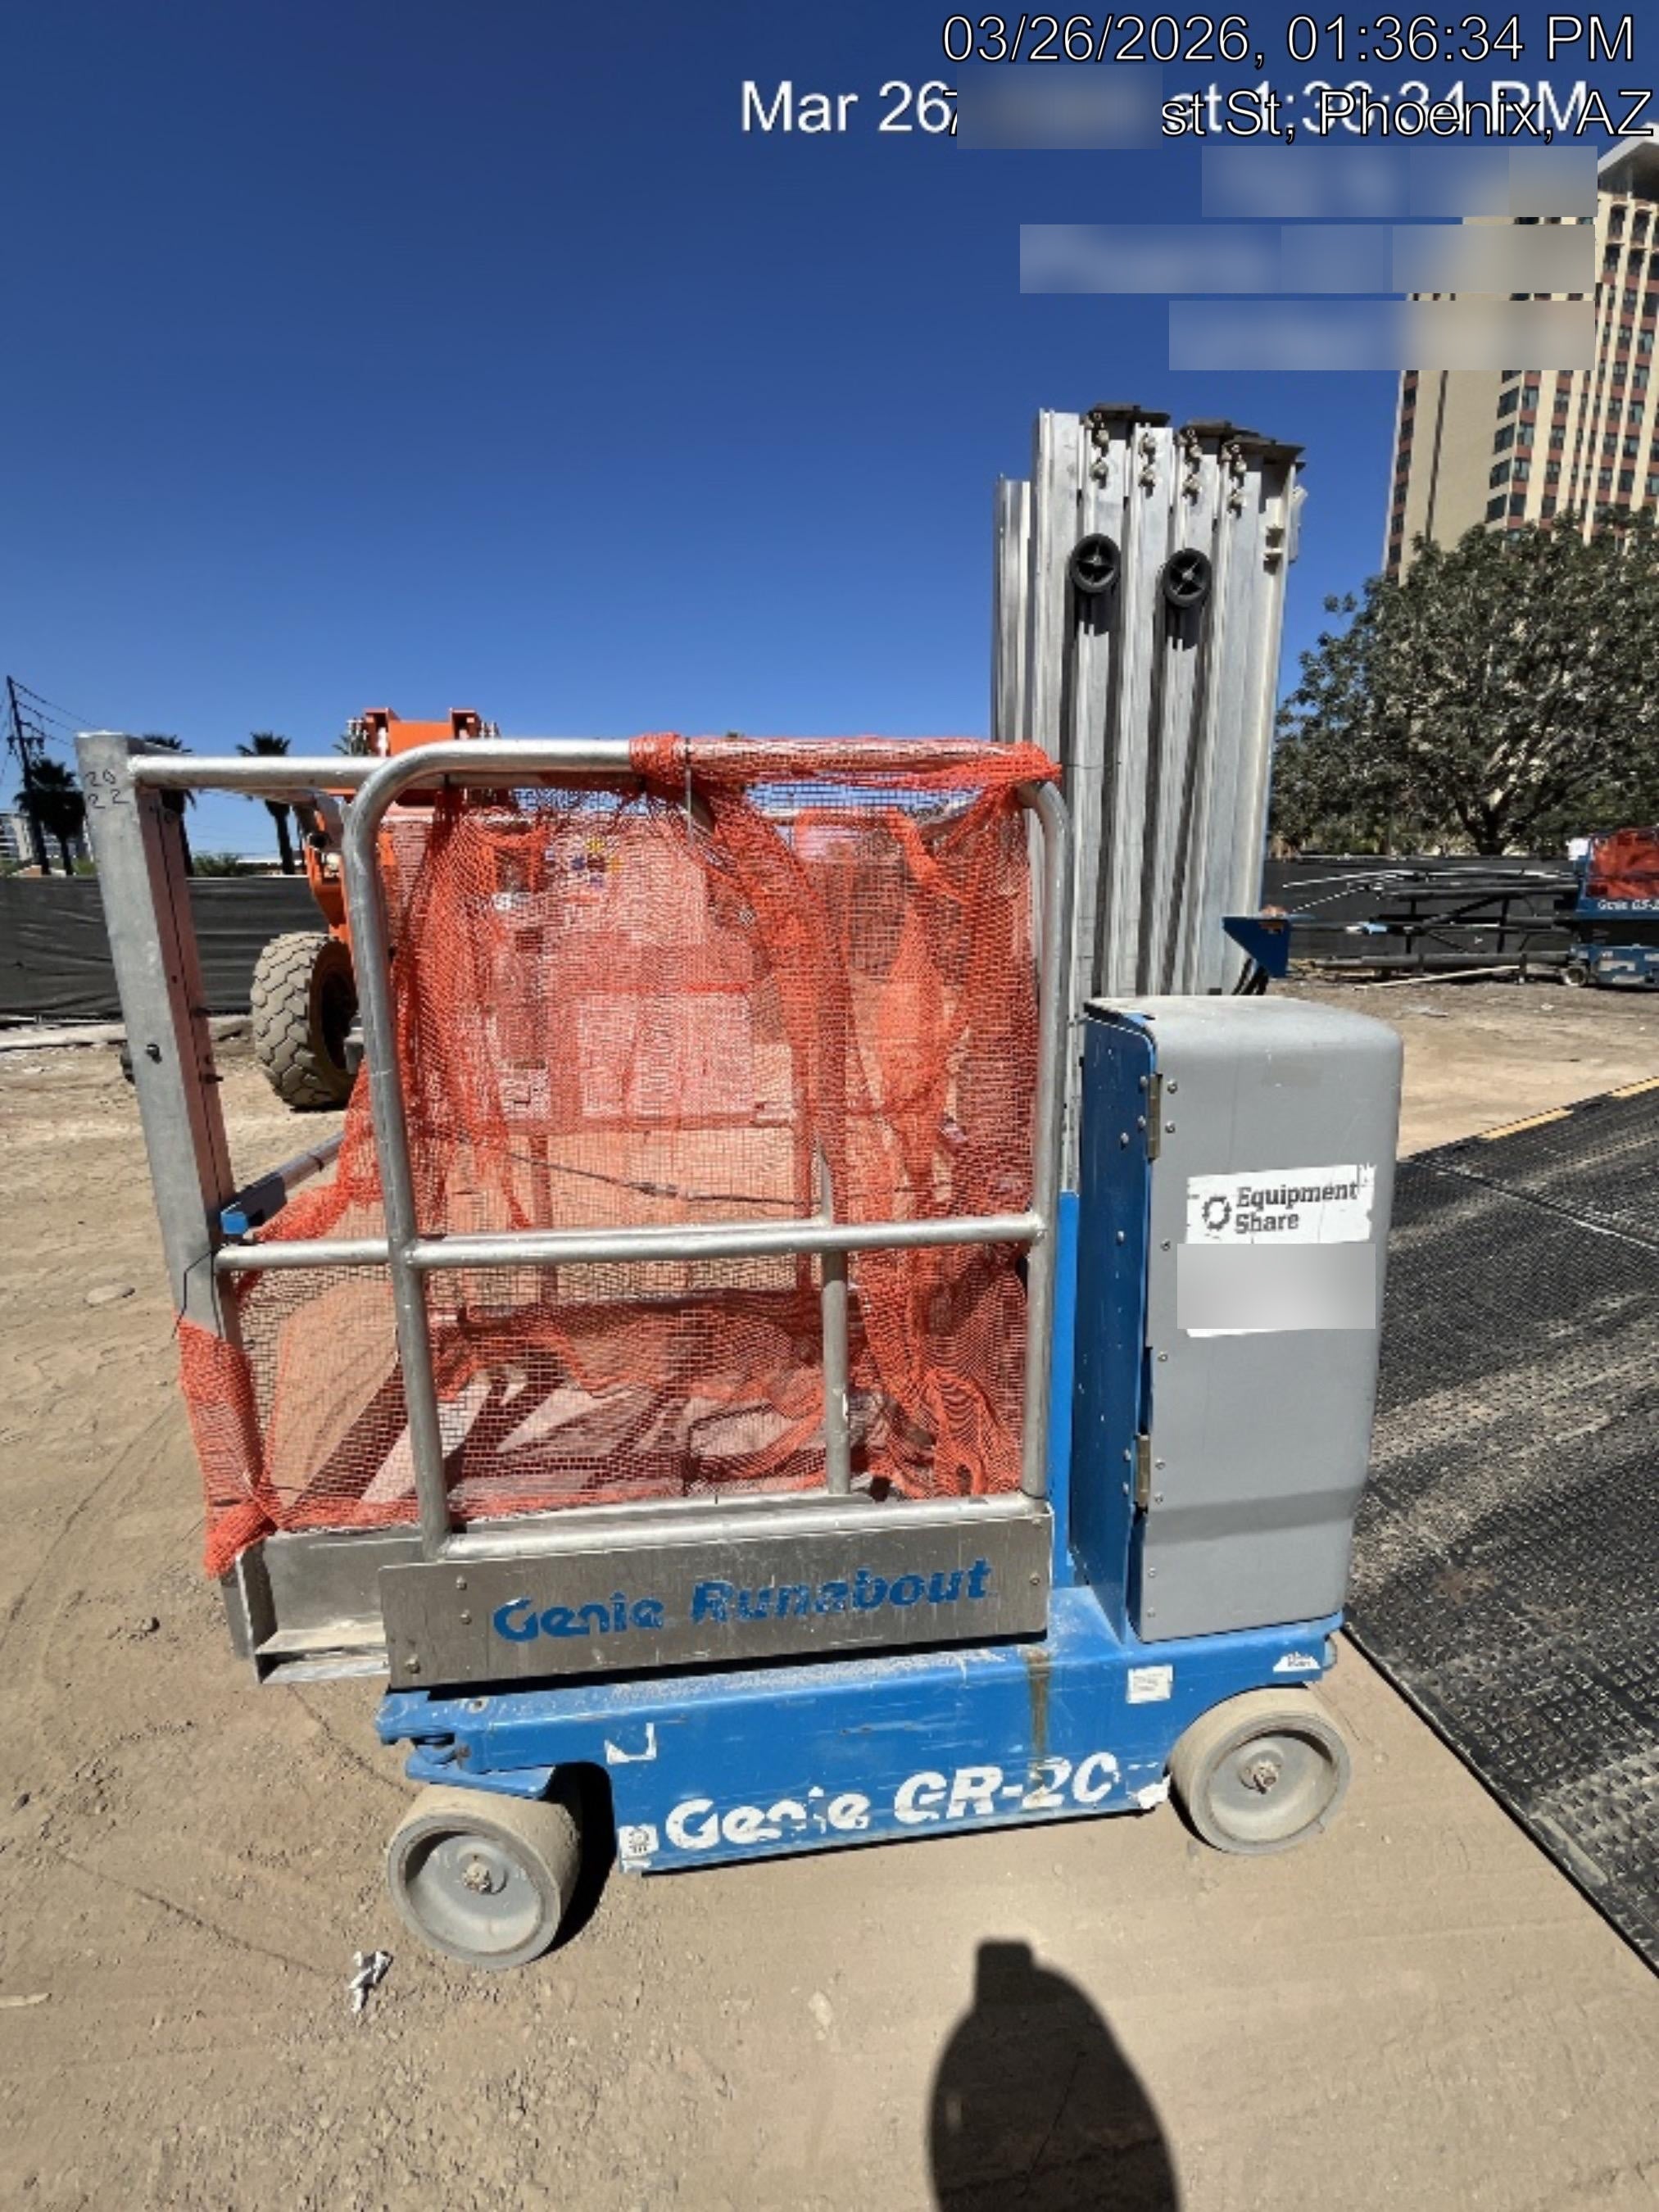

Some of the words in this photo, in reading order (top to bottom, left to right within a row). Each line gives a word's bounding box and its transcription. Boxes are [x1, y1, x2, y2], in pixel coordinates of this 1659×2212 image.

[1235, 1182, 1358, 1213] Equipment
[1235, 1213, 1300, 1234] Share
[492, 1591, 665, 1642] Genie
[690, 1557, 994, 1625] Runabout
